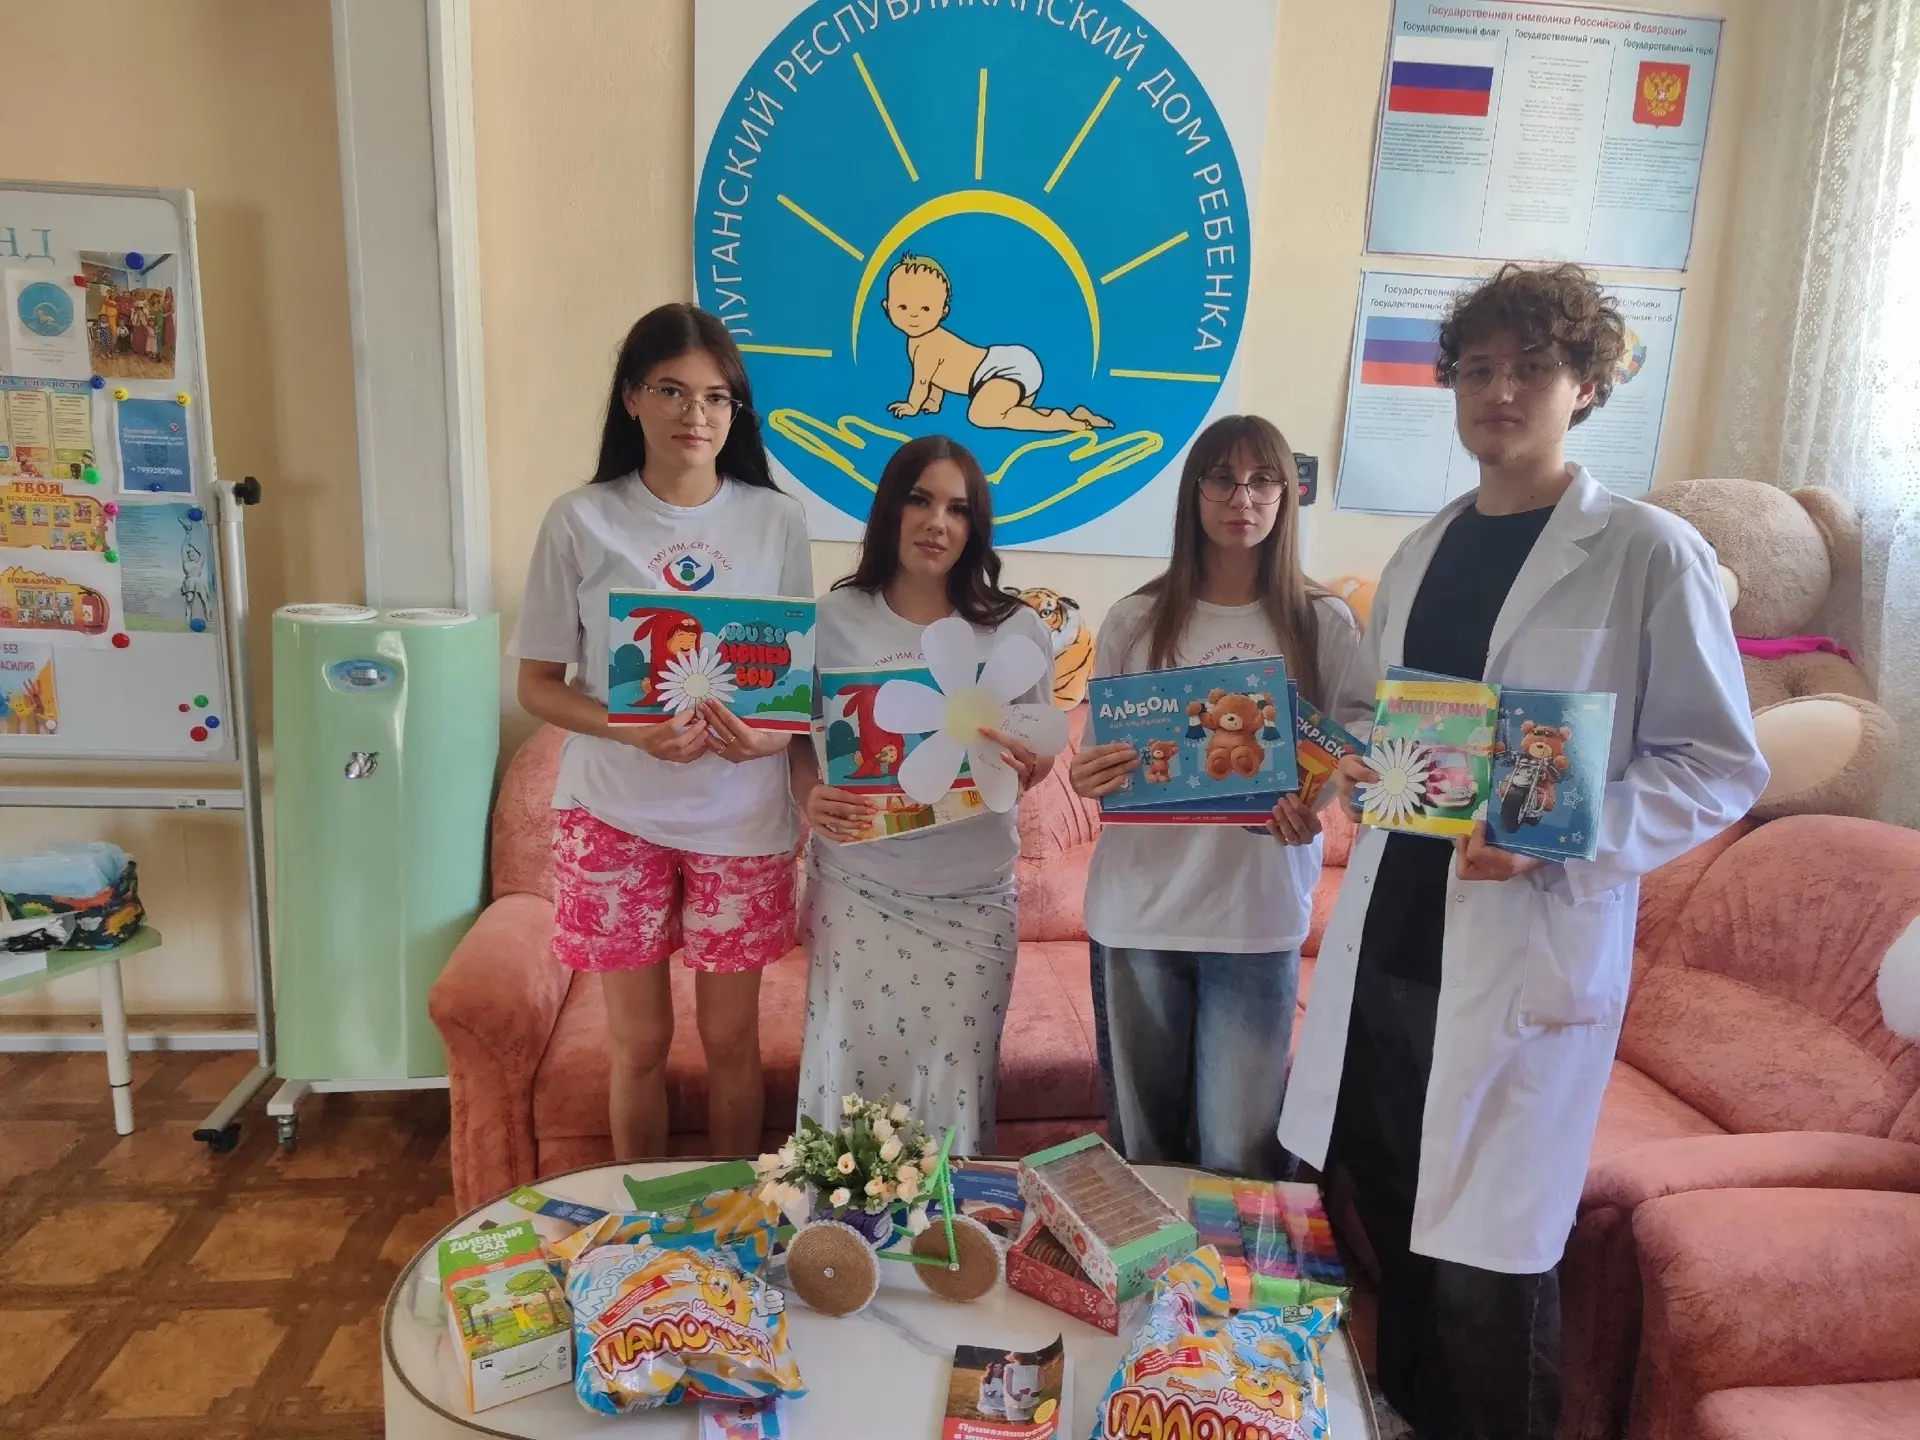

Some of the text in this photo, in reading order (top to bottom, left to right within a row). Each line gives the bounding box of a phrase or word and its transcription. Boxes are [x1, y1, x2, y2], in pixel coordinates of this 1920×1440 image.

[1402, 21, 1501, 37] Государственный флаг
[1428, 4, 1687, 36] Государственная символика Российской Федерации
[1514, 29, 1610, 46] Государственный гимн
[1623, 38, 1694, 53] Государственный
[712, 0, 1235, 351] ЛУГАНСКИЙ РЕСПУБСКИЙ ДОМ РЕБЕНКА
[1370, 298, 1442, 310] Государственный
[12, 482, 60, 494] ТВОЯ
[647, 549, 667, 572] ЛГМУ
[711, 550, 733, 571] ЛУКИ
[725, 624, 787, 644] YOU SO
[3, 643, 18, 654] БЕЗ
[719, 643, 791, 667] HONEY
[873, 654, 893, 667] ГМУ
[734, 665, 776, 689] BOY
[1099, 696, 1180, 721] АЛЬБОМ
[449, 1226, 524, 1255] ДИВНЫЙ
[471, 1240, 509, 1254] САД
[593, 1311, 773, 1376] ПАЛОЧКИ
[1108, 1390, 1287, 1440] ПАЛОЧ
